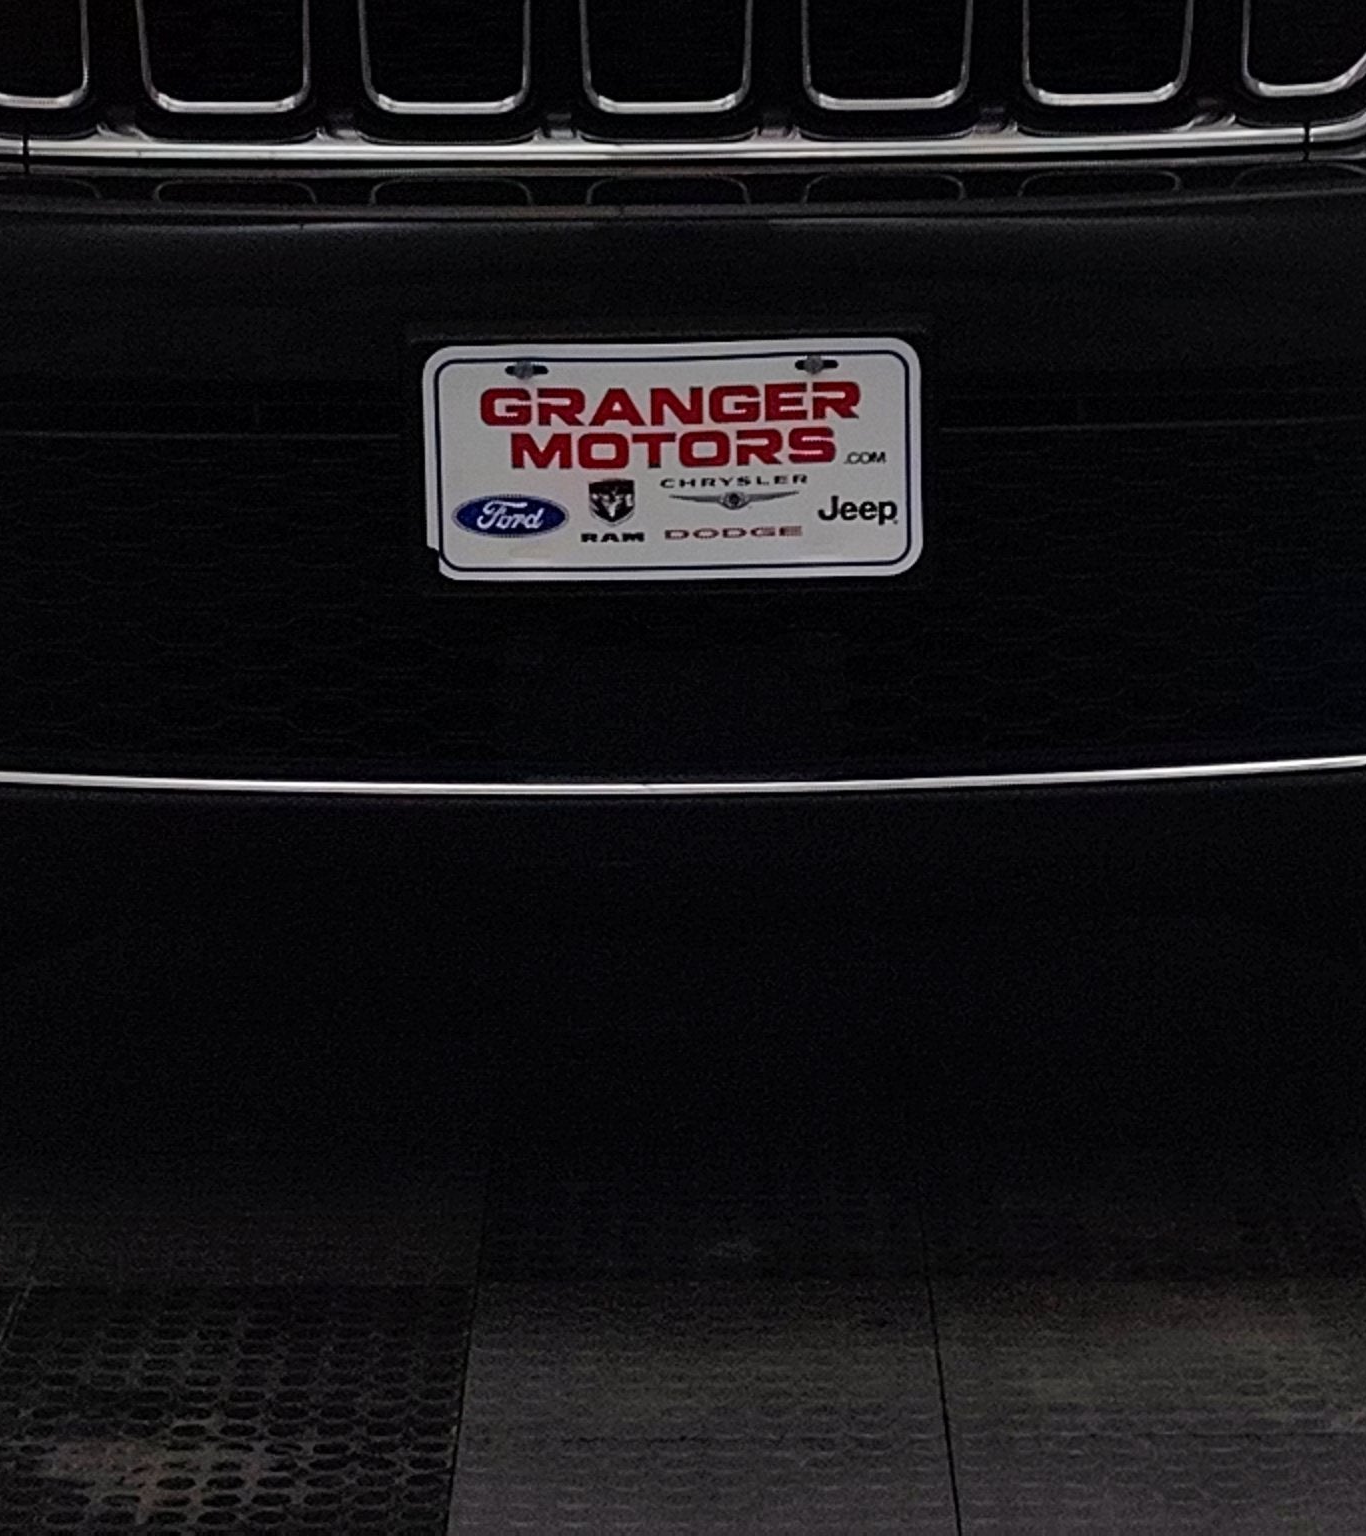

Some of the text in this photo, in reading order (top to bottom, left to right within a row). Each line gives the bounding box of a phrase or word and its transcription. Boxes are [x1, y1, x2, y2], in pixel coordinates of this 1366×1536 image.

[480, 381, 861, 427] GRANGER
[510, 427, 837, 470] MOTORS
[660, 474, 808, 489] CHRYSLER
[476, 500, 545, 529] Ford
[818, 495, 898, 526] Jeep
[580, 532, 645, 543] RAM
[664, 525, 803, 540] DODGE
